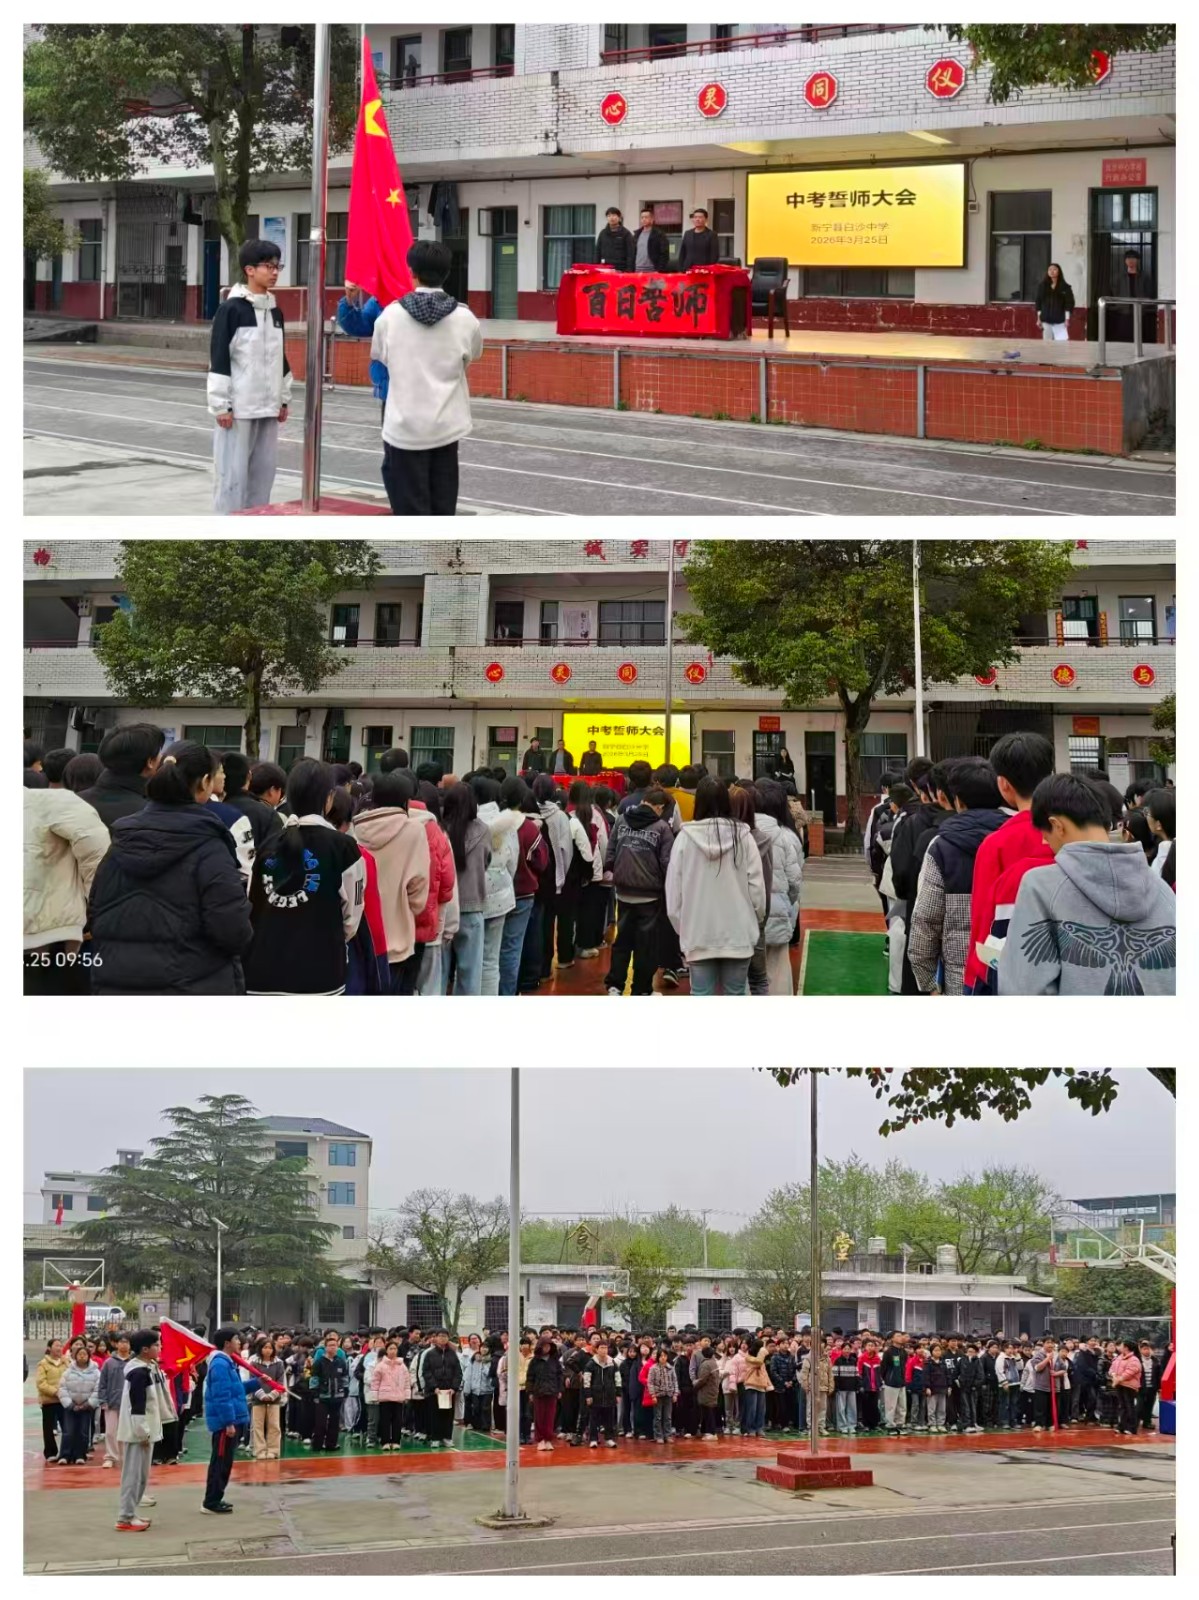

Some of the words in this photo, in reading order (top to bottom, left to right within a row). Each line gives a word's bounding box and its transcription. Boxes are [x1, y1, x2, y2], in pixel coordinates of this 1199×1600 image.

[703, 86, 721, 111] 灵
[812, 76, 830, 101] 同
[931, 66, 959, 91] 仪
[786, 188, 917, 209] 中考誓师大会
[811, 235, 888, 245] 2026年3月25日
[582, 278, 709, 329] 百日誓师
[587, 725, 665, 736] 中考誓师大会
